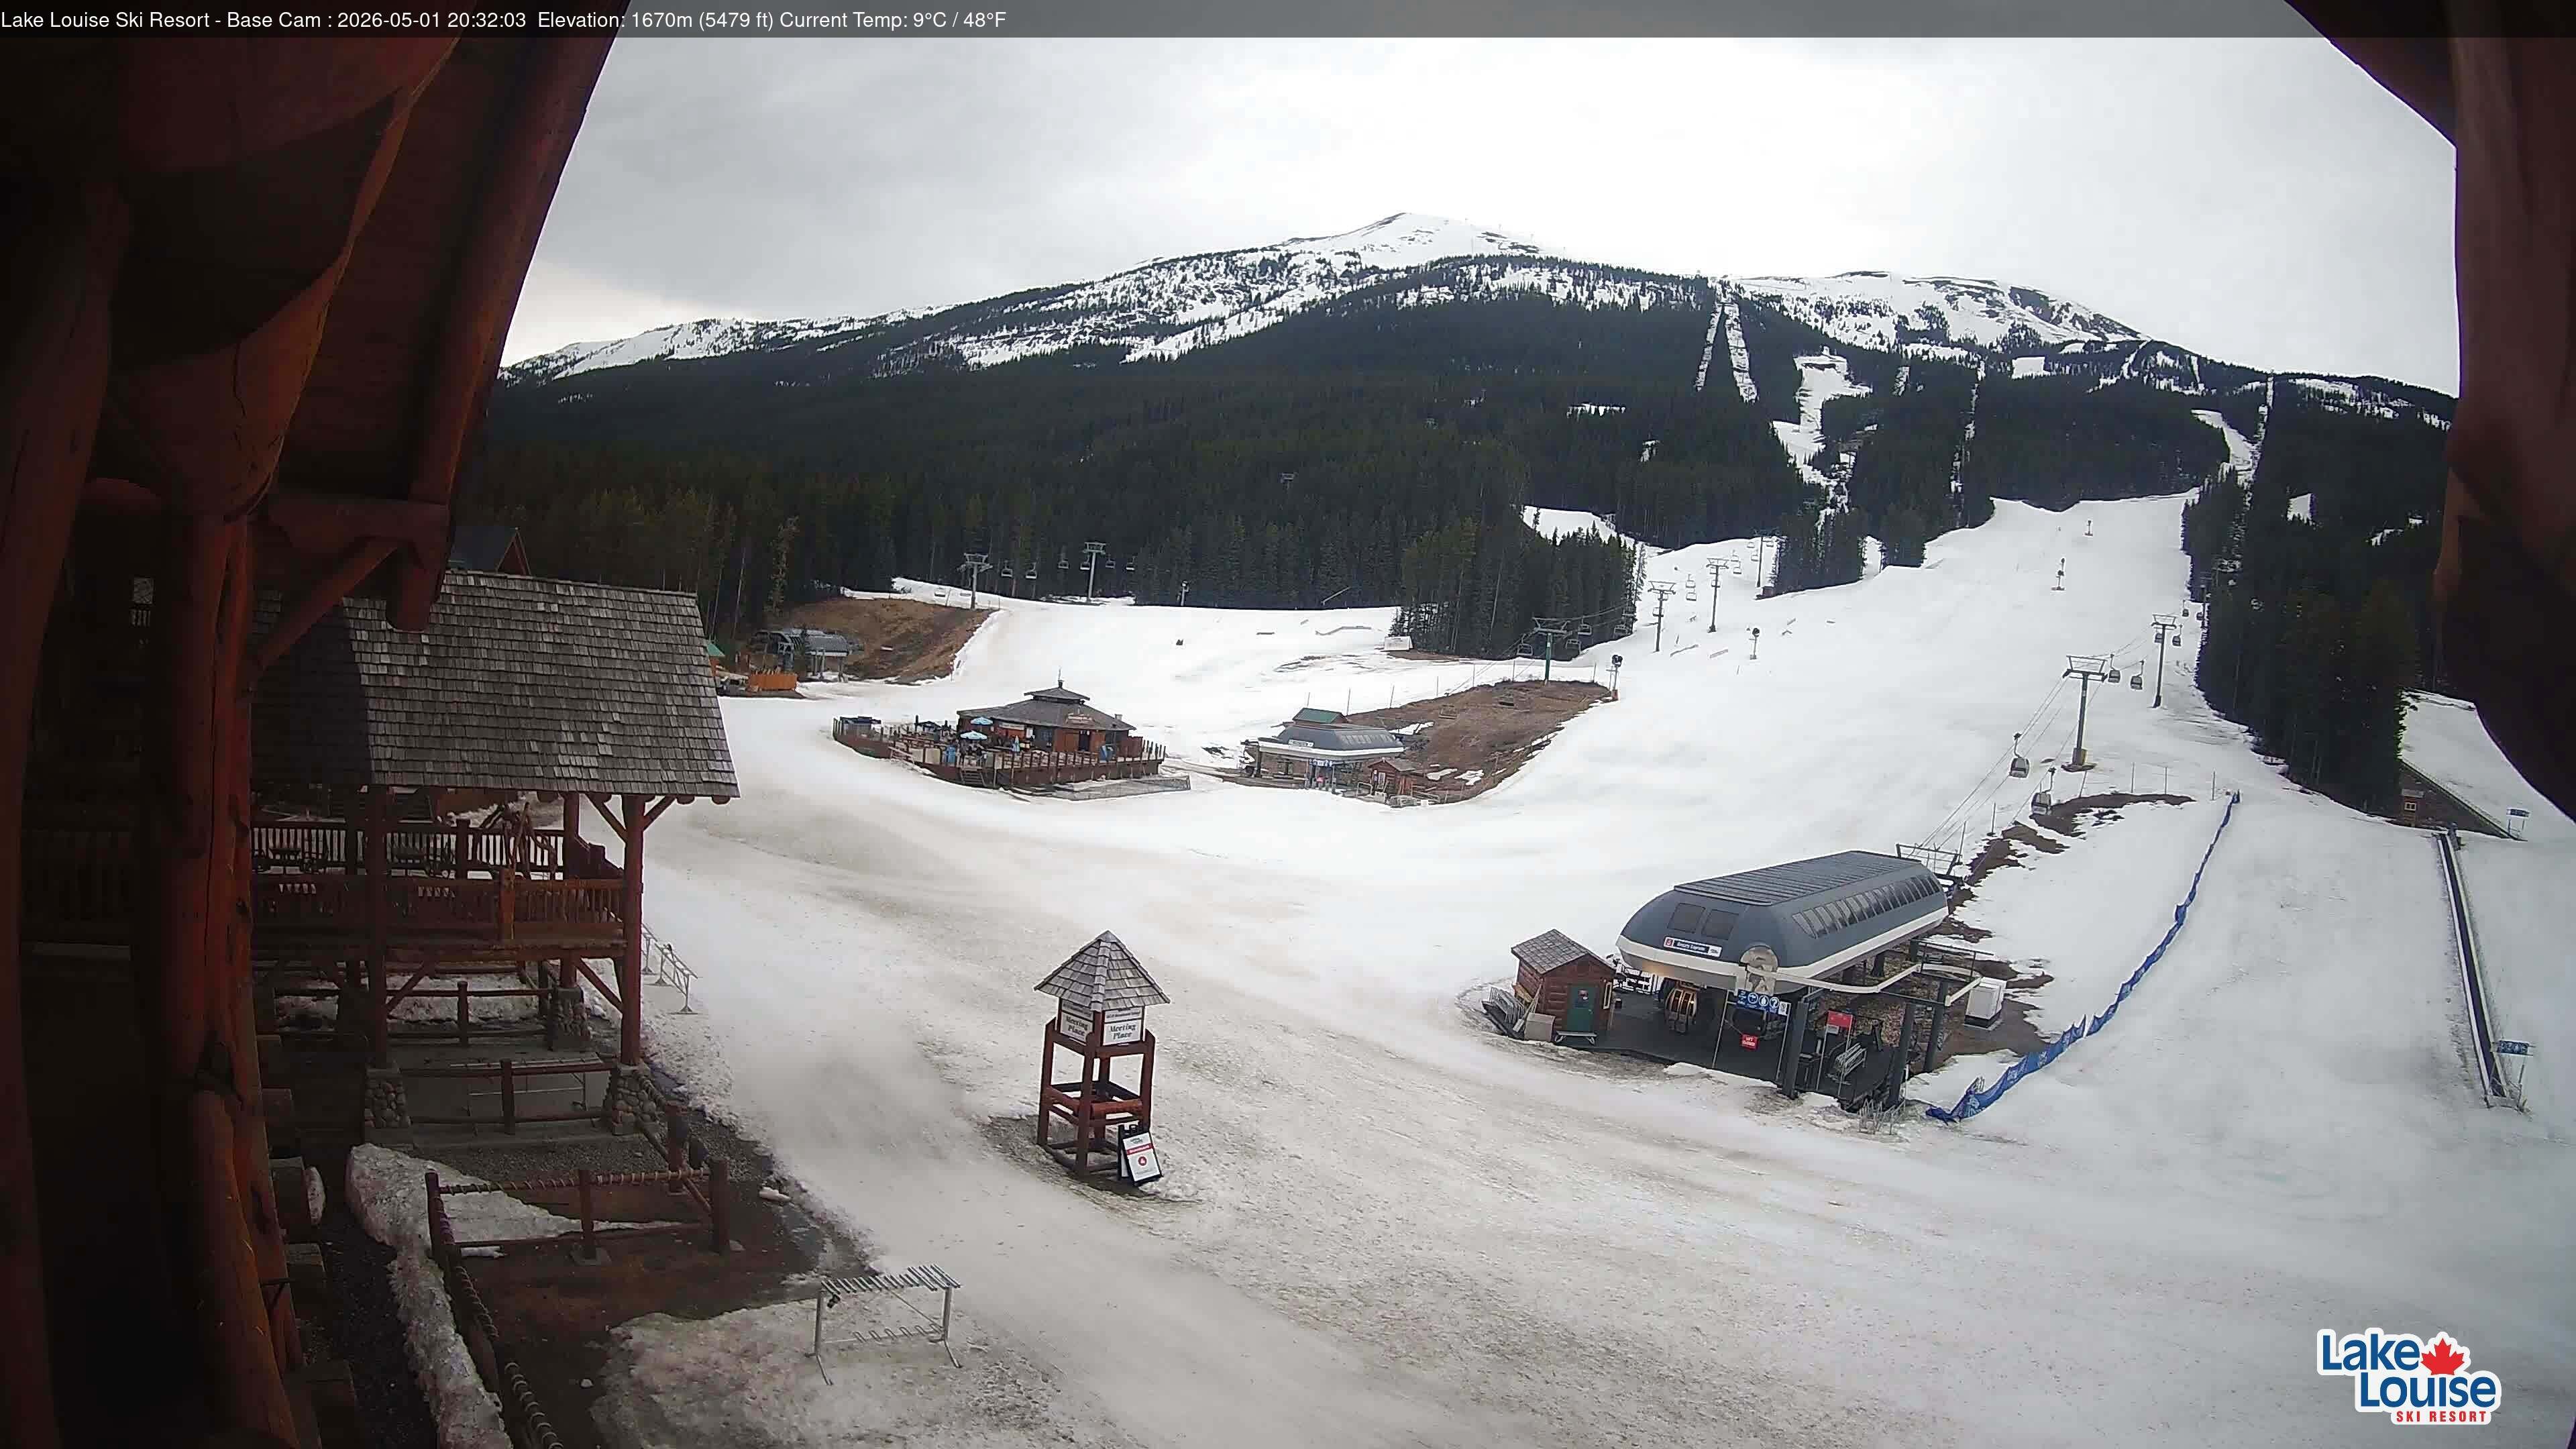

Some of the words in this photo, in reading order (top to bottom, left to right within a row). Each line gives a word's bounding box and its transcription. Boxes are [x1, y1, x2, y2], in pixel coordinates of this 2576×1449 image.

[1068, 1025, 1085, 1036] Place
[1110, 1024, 1136, 1032] Meeting
[1113, 1032, 1132, 1040] Place
